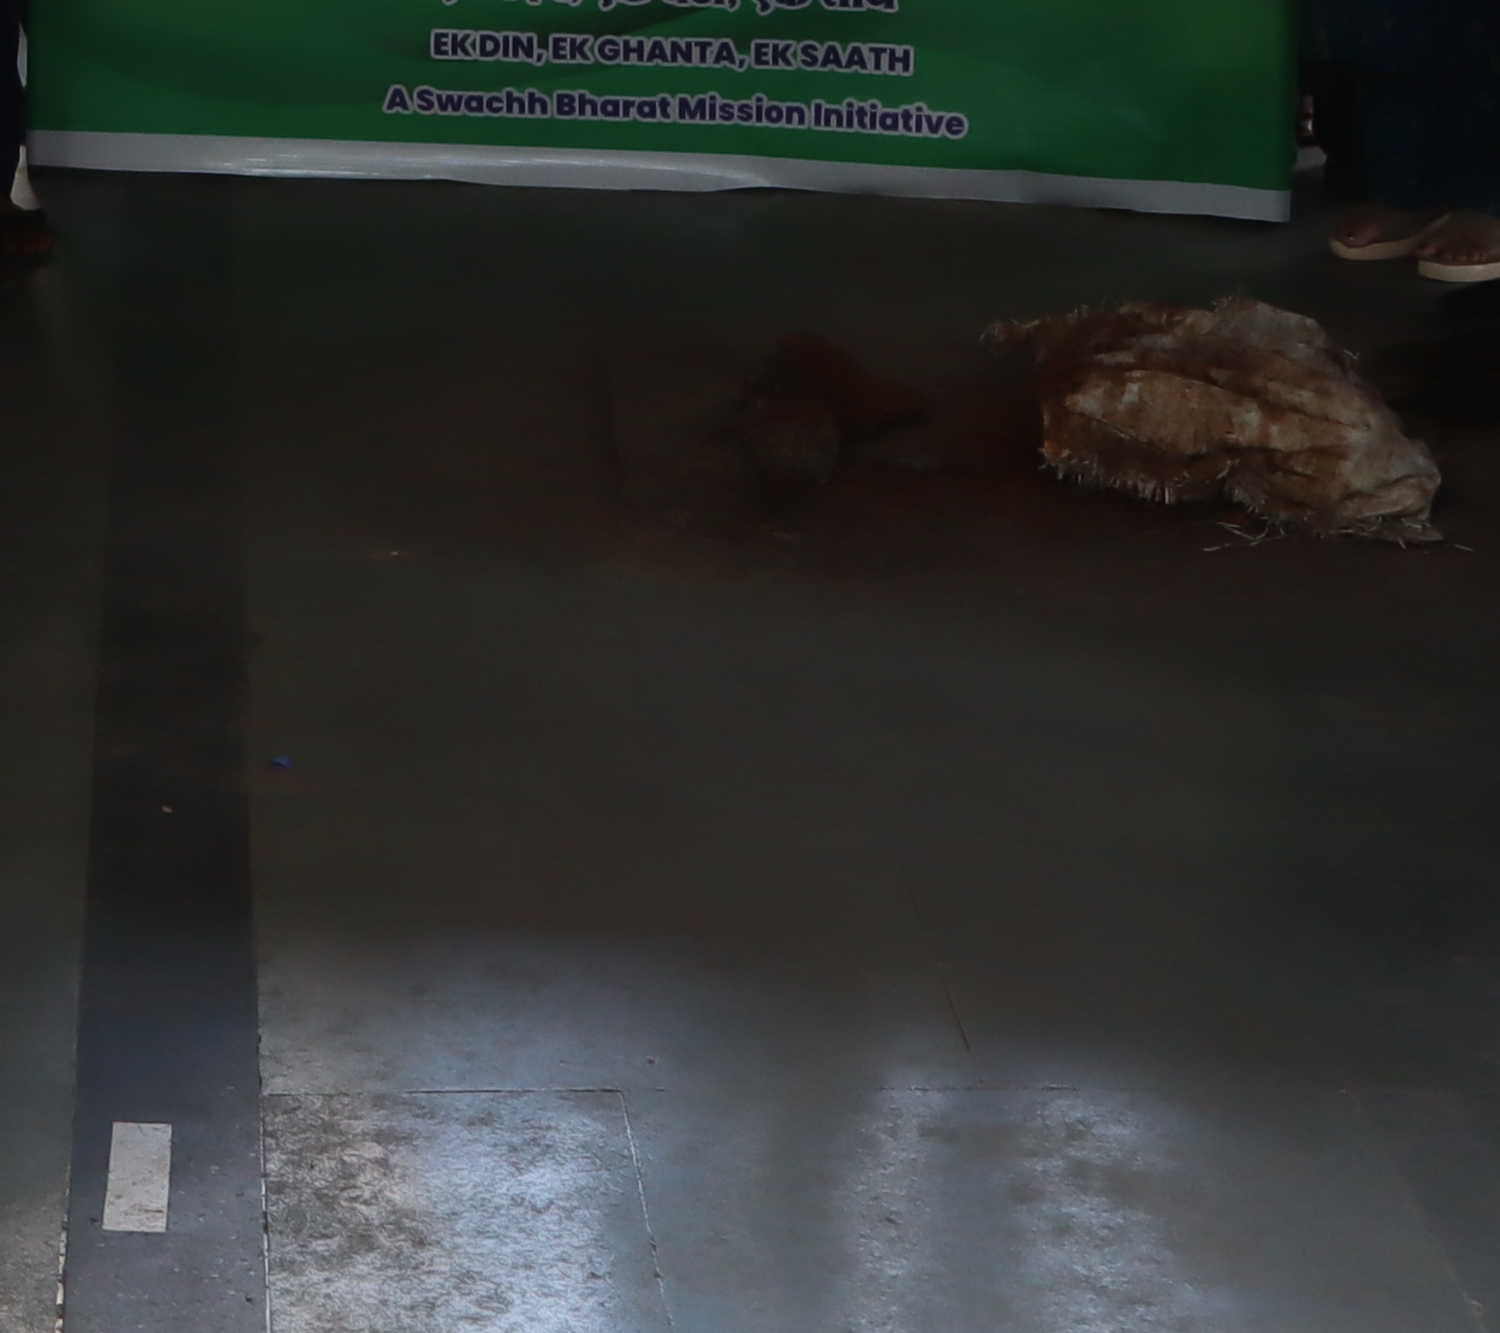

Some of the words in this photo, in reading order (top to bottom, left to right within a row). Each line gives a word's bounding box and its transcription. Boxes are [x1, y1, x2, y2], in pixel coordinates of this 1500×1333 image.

[432, 31, 476, 58] EK
[478, 33, 546, 65] DIN,
[551, 36, 591, 61] EK
[598, 38, 748, 70] GHANTA,
[754, 43, 796, 66] EK
[800, 43, 912, 74] SAATH
[386, 88, 409, 113] A
[416, 88, 548, 116] Swachh
[555, 93, 671, 120] Bharat
[678, 95, 805, 126] Mission
[813, 102, 966, 137] Initiative
